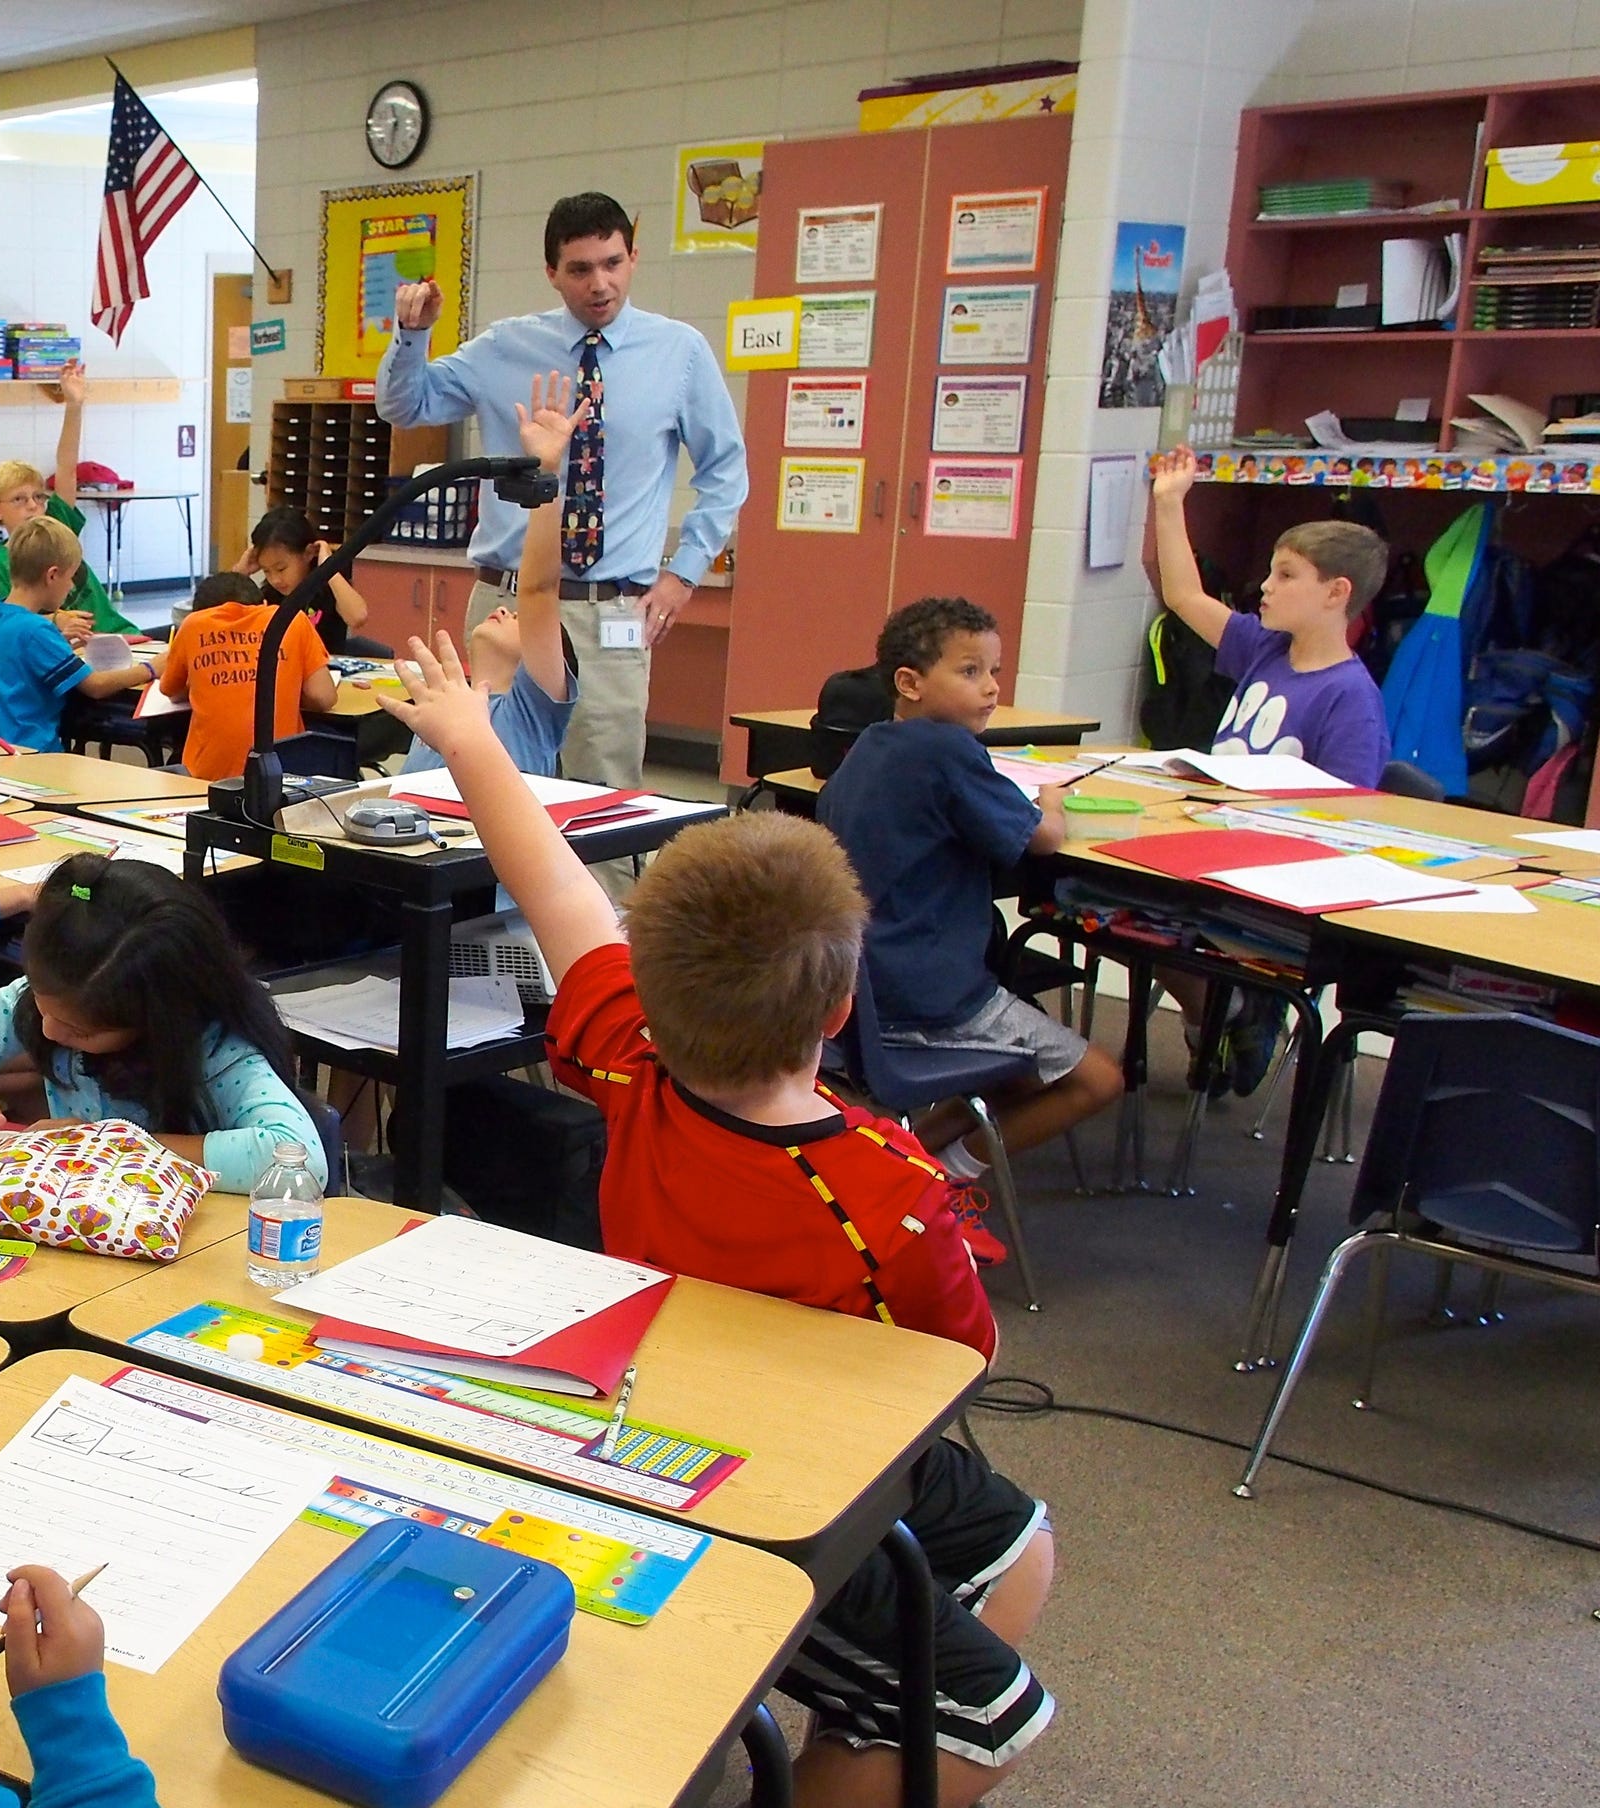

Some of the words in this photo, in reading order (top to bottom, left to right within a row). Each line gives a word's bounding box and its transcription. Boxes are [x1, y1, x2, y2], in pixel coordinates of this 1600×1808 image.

[367, 218, 405, 235] STAR
[742, 327, 782, 349] East
[200, 630, 227, 648] LAS
[229, 630, 265, 646] VEGA
[193, 650, 251, 671] COUNTY
[287, 838, 309, 849] CAUTION
[400, 1496, 426, 1508] Money
